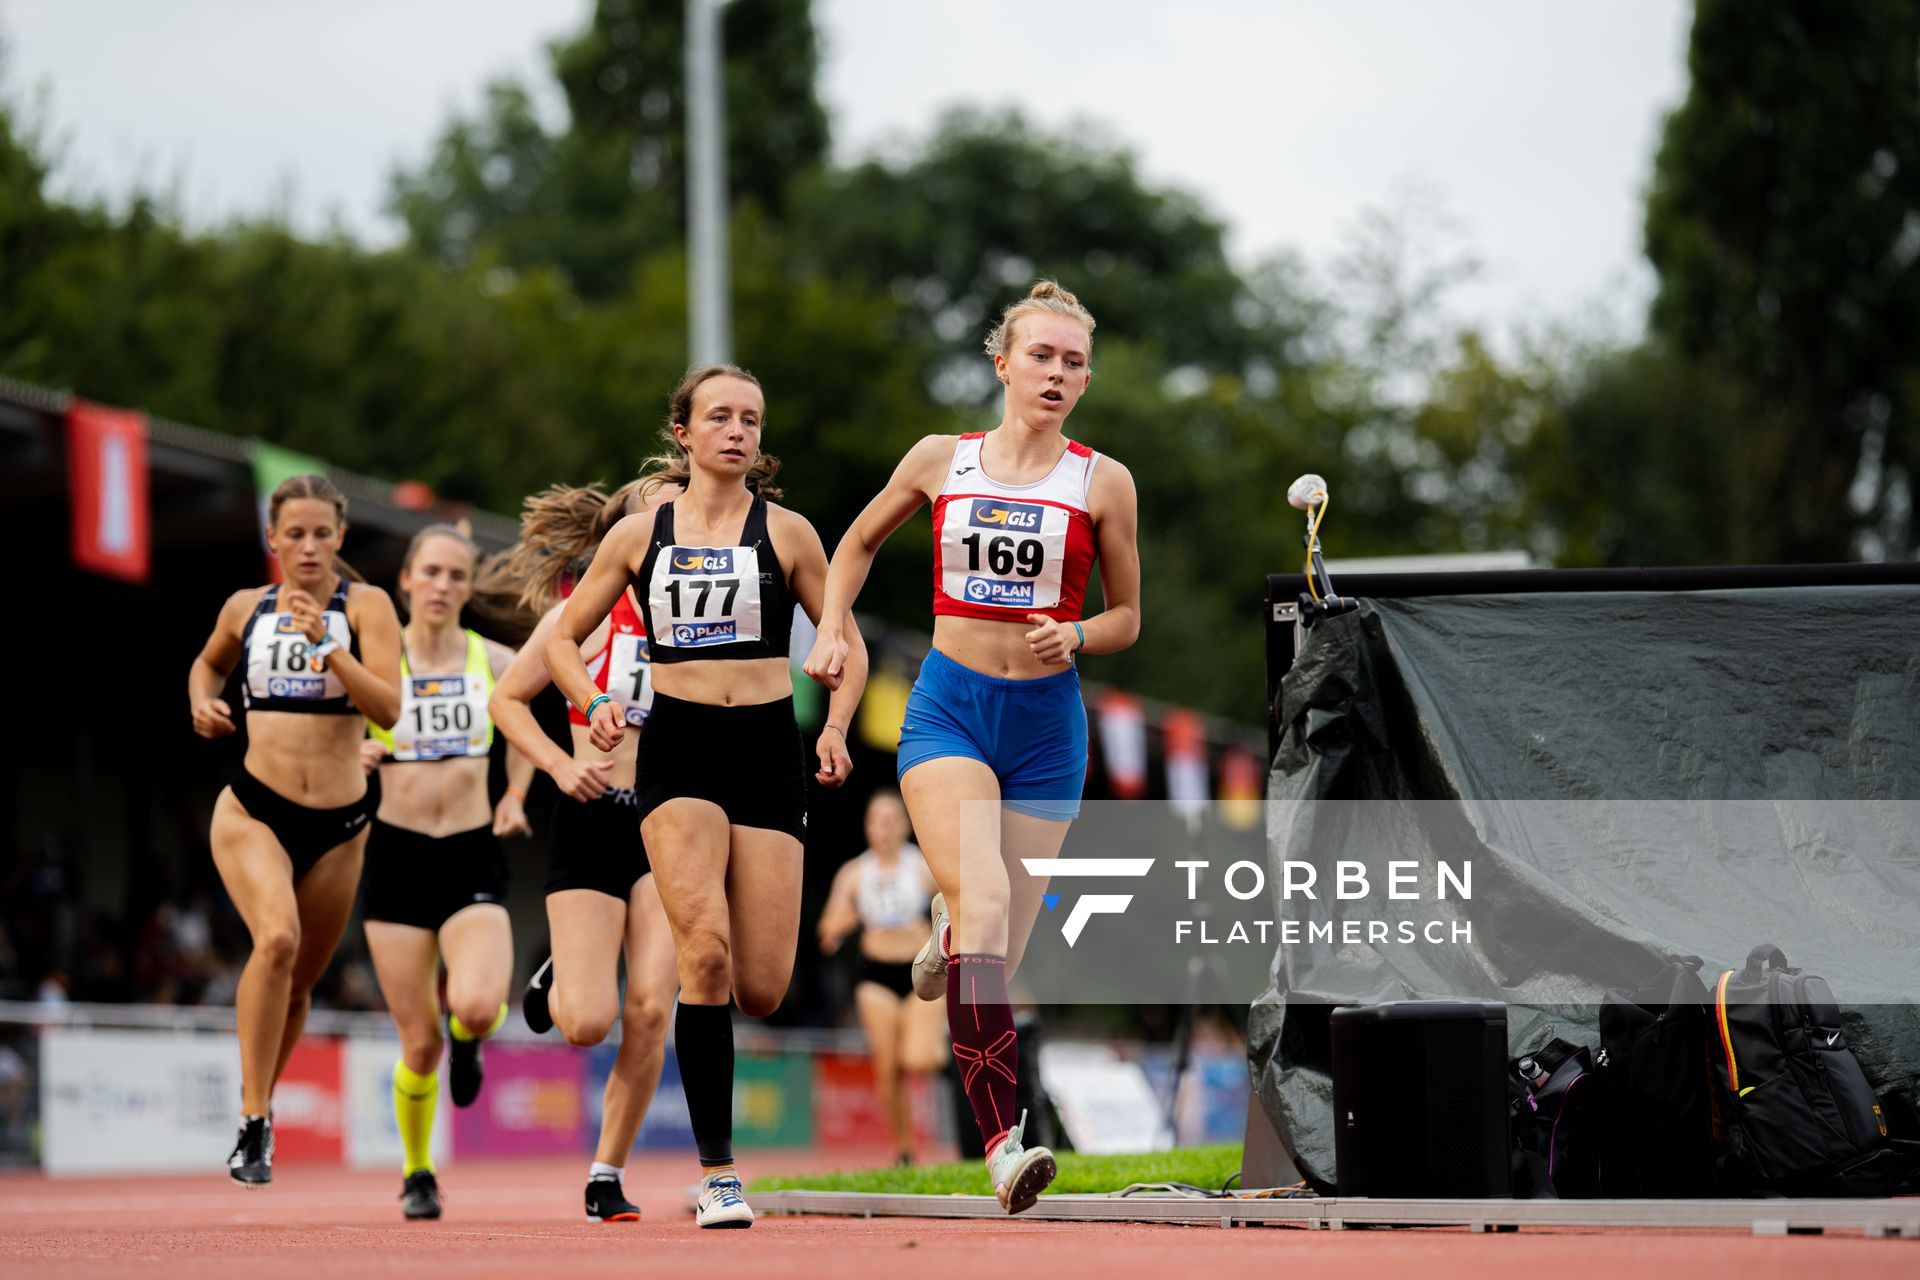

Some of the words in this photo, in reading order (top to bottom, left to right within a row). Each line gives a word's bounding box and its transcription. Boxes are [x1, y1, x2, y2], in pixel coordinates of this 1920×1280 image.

[1007, 511, 1037, 527] GLS
[703, 556, 727, 570] GLS
[962, 533, 1044, 577] 169
[665, 579, 740, 618] 177
[992, 584, 1031, 598] PLAN
[696, 625, 733, 638] PLAN
[267, 640, 330, 673] 18
[290, 680, 323, 692] PLAN
[411, 703, 472, 732] 150
